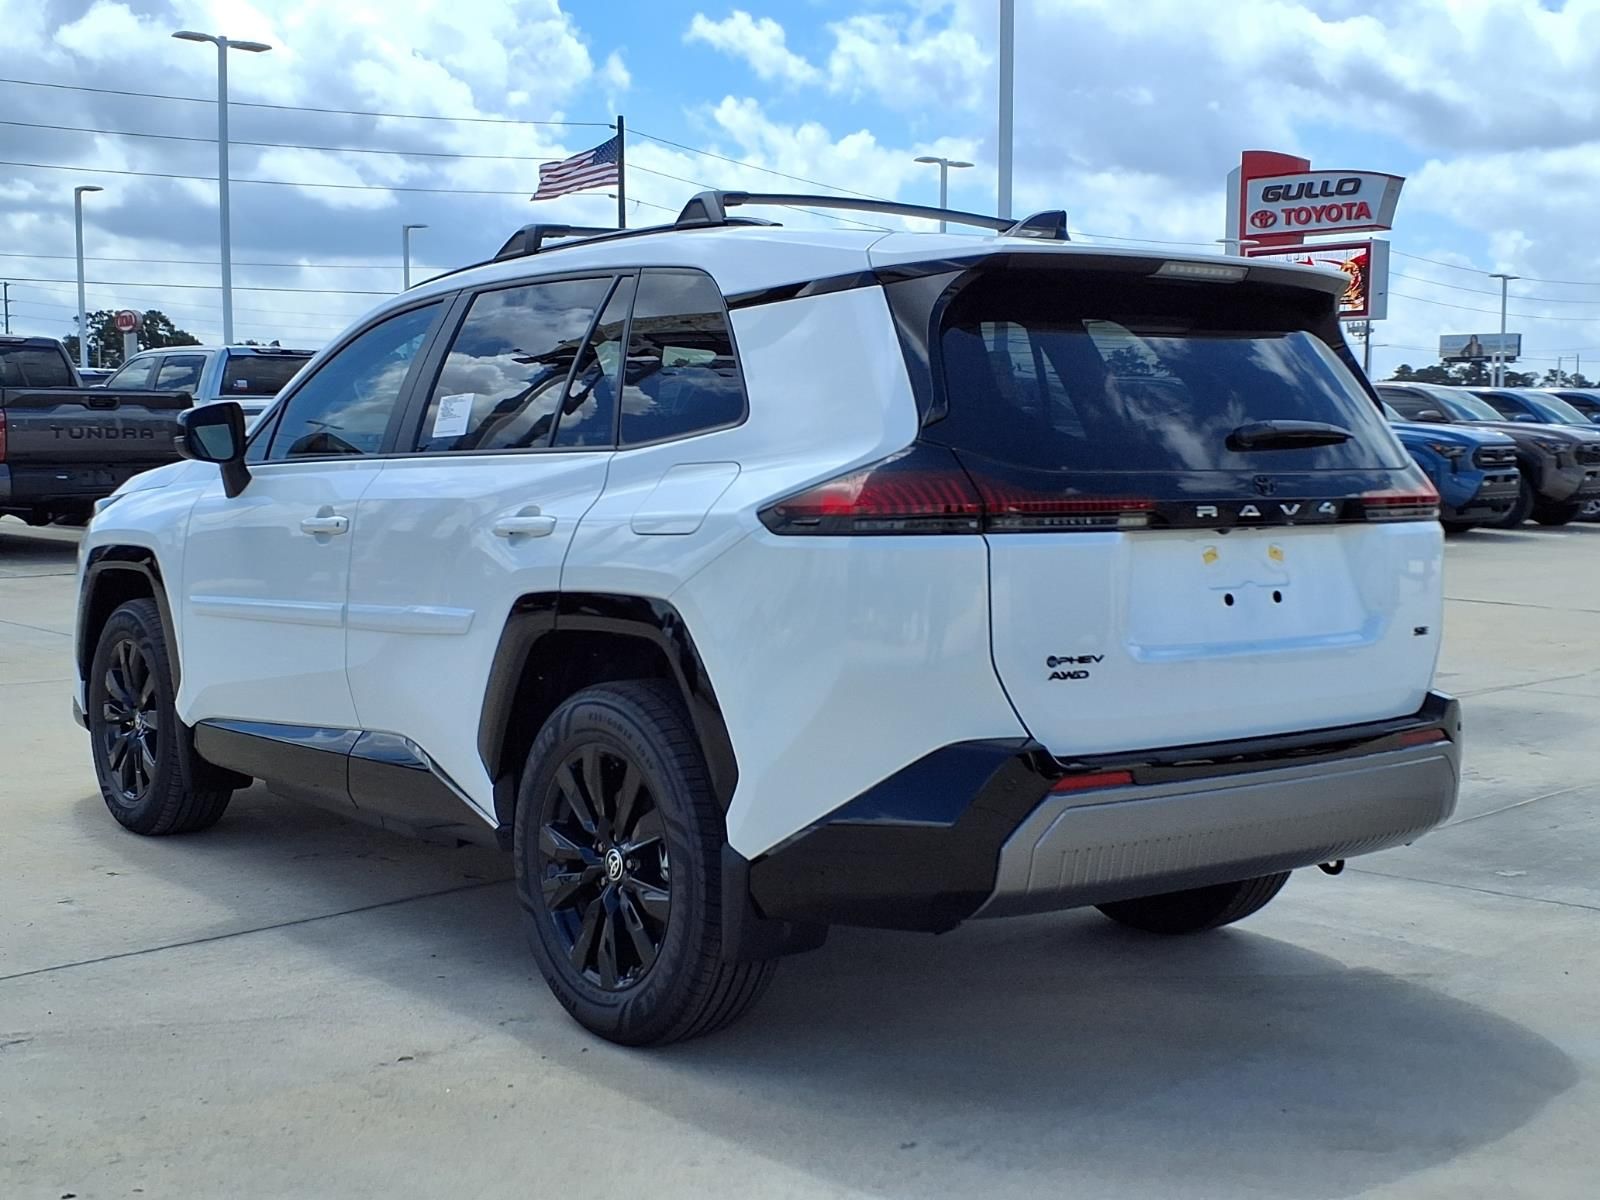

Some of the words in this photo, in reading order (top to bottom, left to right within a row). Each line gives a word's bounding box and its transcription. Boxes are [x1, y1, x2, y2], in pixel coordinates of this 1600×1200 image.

[1261, 177, 1362, 203] GULLO
[1281, 201, 1372, 226] TOYOTA
[51, 425, 154, 439] TUNDRA
[1196, 501, 1336, 518] RAV4
[1056, 654, 1104, 666] PHEV
[1047, 669, 1090, 681] AWD
